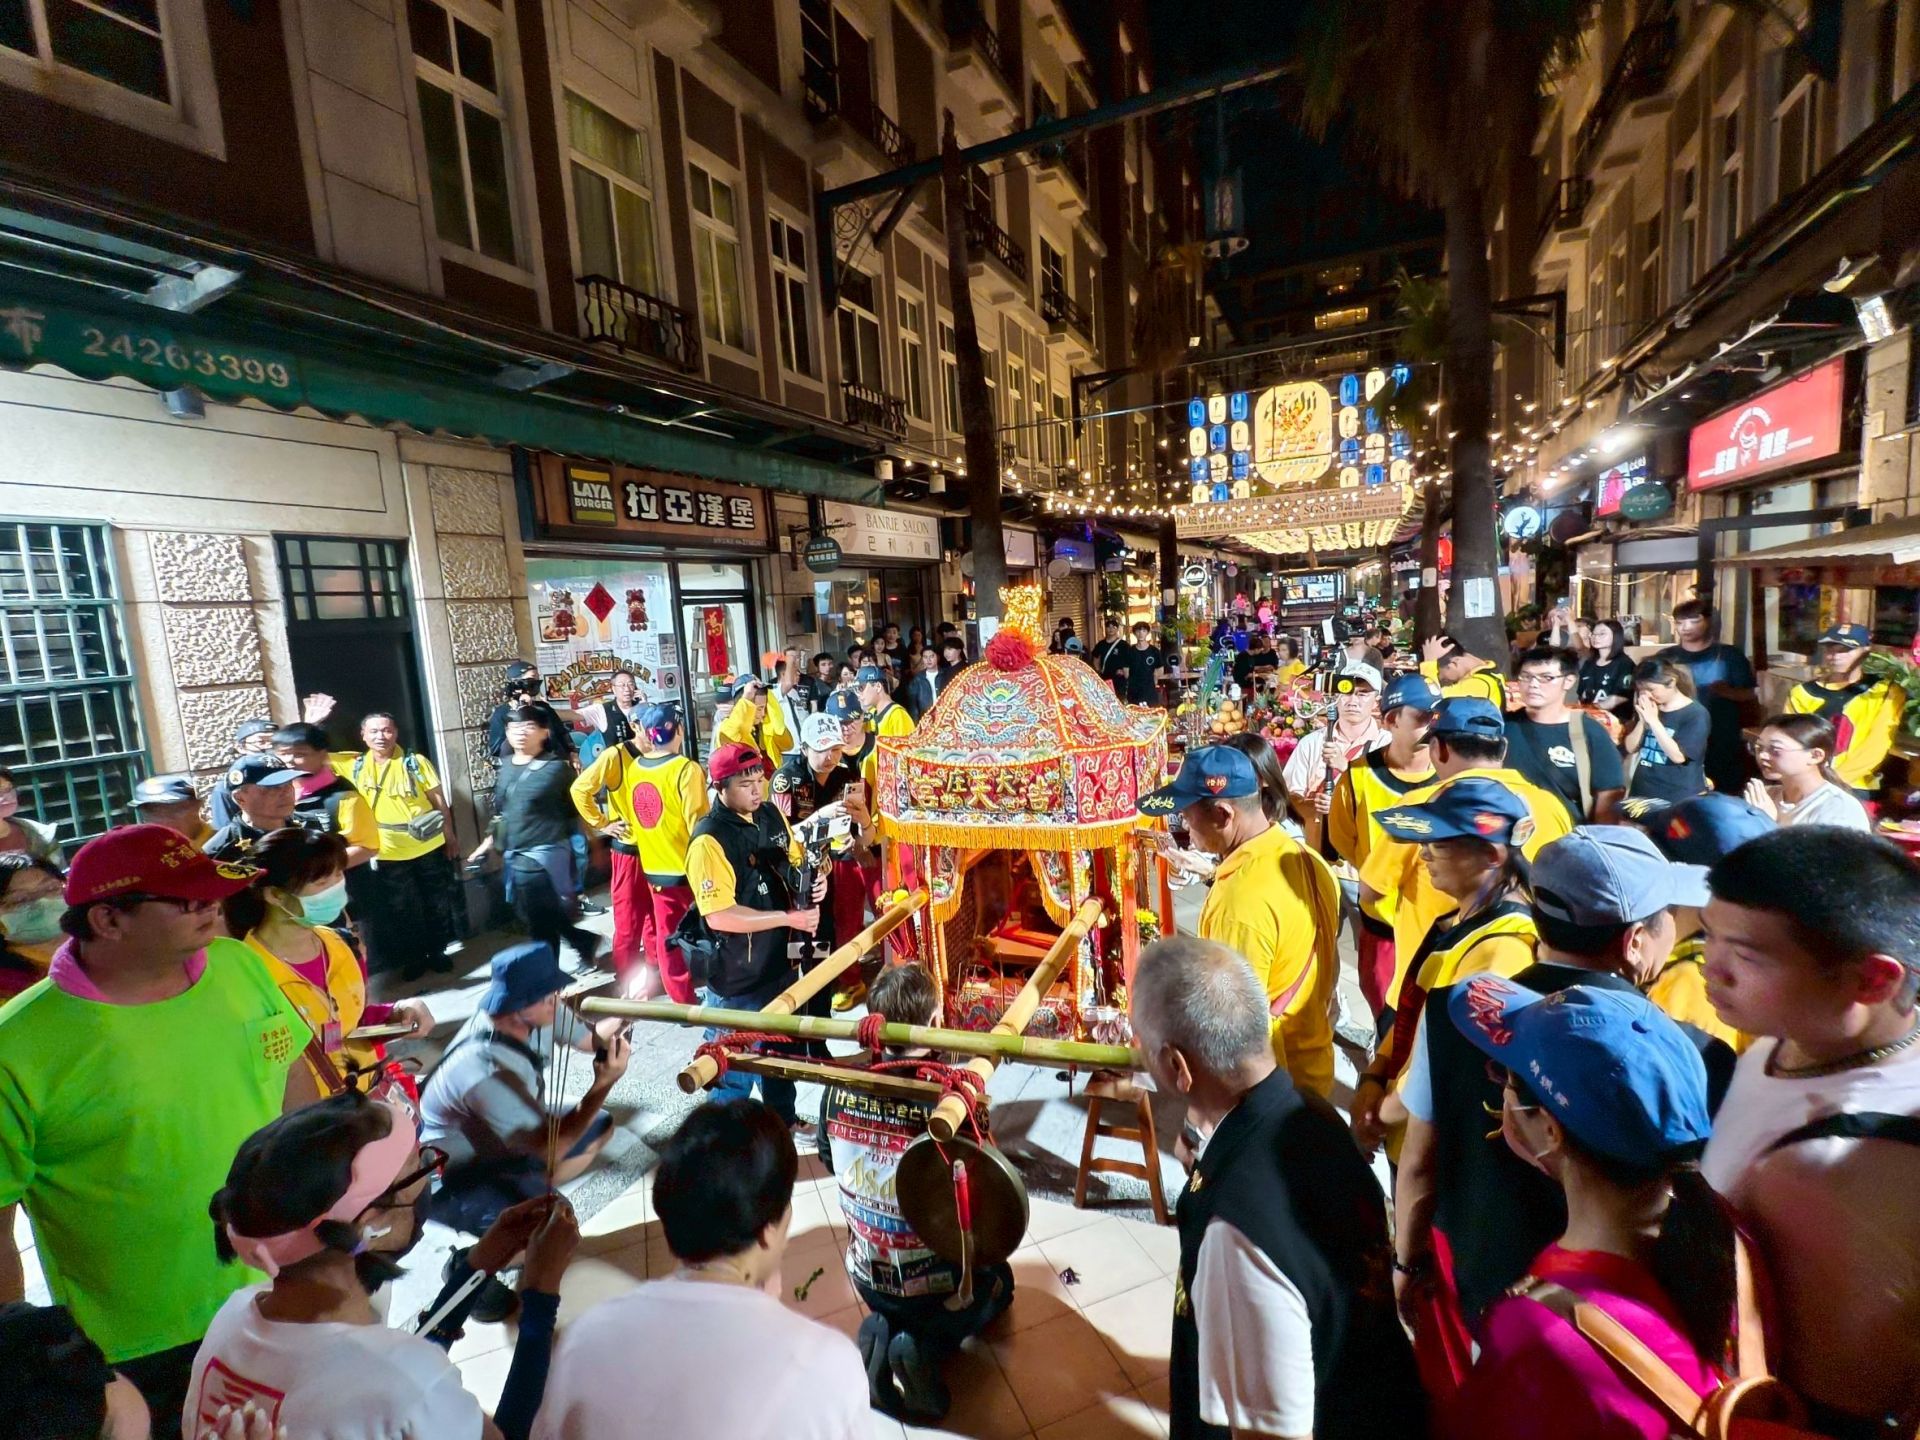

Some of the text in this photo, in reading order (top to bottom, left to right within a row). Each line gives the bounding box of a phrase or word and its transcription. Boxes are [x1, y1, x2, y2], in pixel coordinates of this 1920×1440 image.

[83, 328, 290, 388] 24263399
[572, 481, 612, 500] LAYA
[574, 497, 613, 511] BURGER
[625, 482, 755, 529] 拉亞漢堡
[865, 513, 930, 534] BANRIE SALON
[549, 661, 589, 691] LAYA
[590, 656, 652, 684] BURGER
